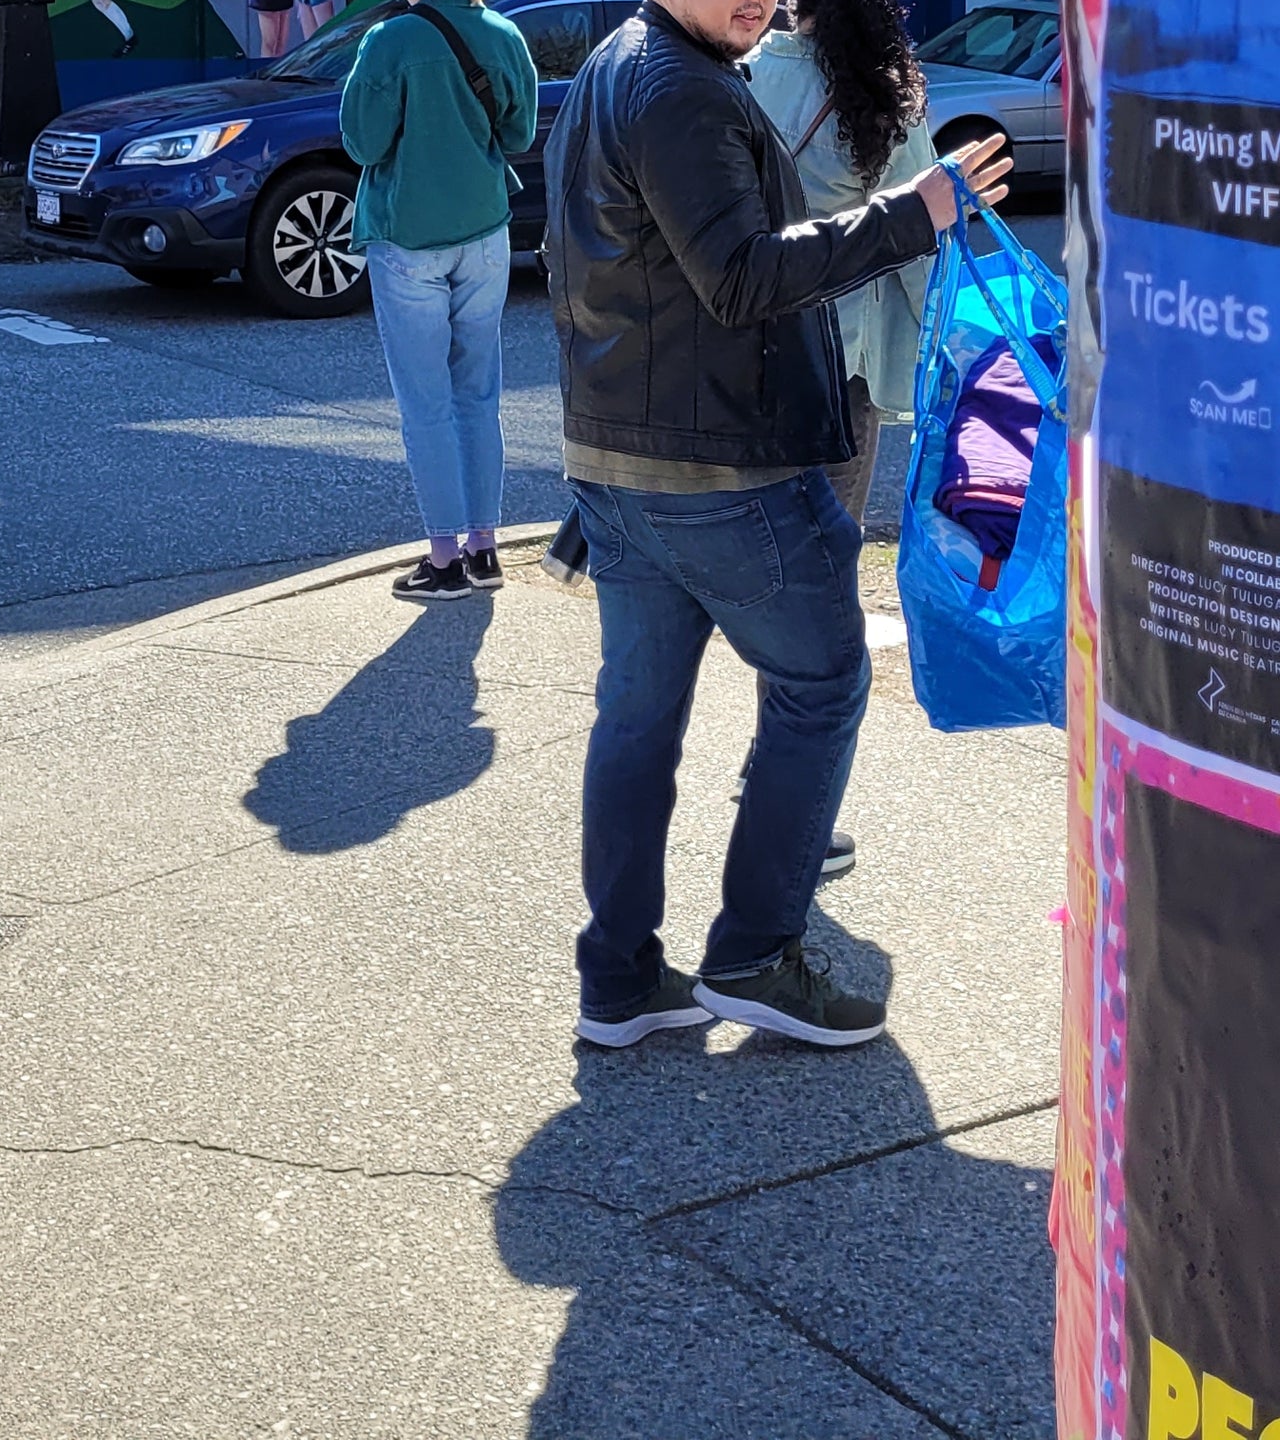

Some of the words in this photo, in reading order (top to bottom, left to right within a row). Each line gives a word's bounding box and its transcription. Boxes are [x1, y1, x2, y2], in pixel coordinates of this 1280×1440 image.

[1154, 117, 1254, 167] Playing
[1212, 181, 1280, 220] VIFF
[1124, 270, 1271, 343] Tickets
[1189, 395, 1228, 425] SCAN
[1233, 409, 1258, 428] ME
[1208, 539, 1273, 566] PRODUCED
[1221, 564, 1234, 579] IN
[1131, 553, 1195, 585] DIRECTORS
[1199, 575, 1228, 594] LUCY
[1147, 580, 1225, 617] PRODUCTION
[1140, 617, 1194, 648] ORIGINAL
[1197, 638, 1240, 662] MUSIC
[1149, 601, 1200, 629] WRITERS
[1204, 618, 1236, 641] LUCY
